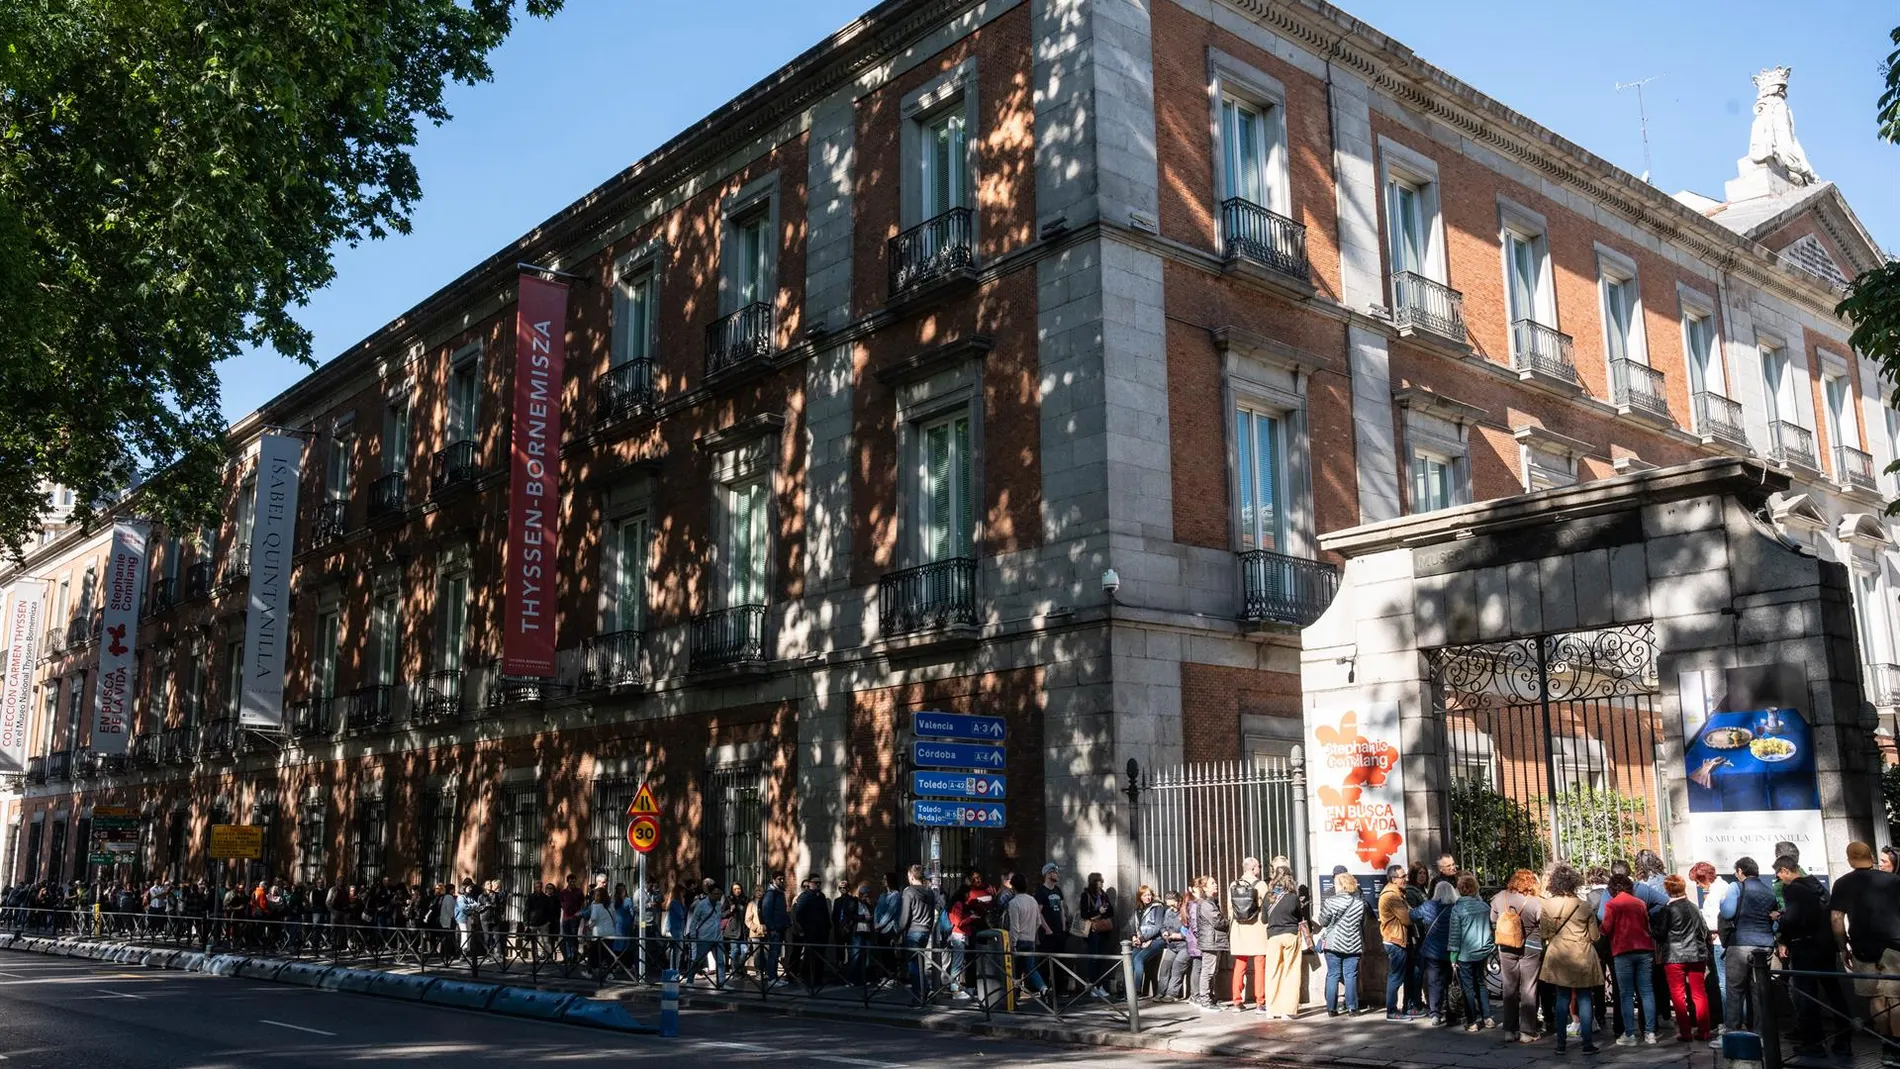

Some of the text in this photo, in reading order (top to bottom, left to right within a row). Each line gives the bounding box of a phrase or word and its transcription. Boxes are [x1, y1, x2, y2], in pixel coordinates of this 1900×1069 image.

[267, 457, 288, 526] ISABEL
[520, 319, 552, 634] THYSSEN-BORNEMISZA
[110, 554, 126, 611] Stephanie
[121, 556, 138, 611] Comilang
[14, 600, 27, 642] THYSSEN
[256, 532, 282, 679] QUINTANILLA
[9, 645, 22, 687] CARMEN
[19, 672, 30, 703] Nacional
[100, 672, 115, 733] EN BUSCA
[110, 666, 126, 734] DE LA VIDA
[16, 704, 26, 729] Museo
[918, 720, 988, 733] Valencia A-3
[16, 738, 22, 748] en
[918, 748, 956, 759] Córdoba
[918, 780, 948, 789] Toledo
[1347, 803, 1393, 818] BUSCA
[1363, 817, 1398, 831] VIDA
[636, 828, 654, 840] 30
[1705, 834, 1736, 843] ISABEL
